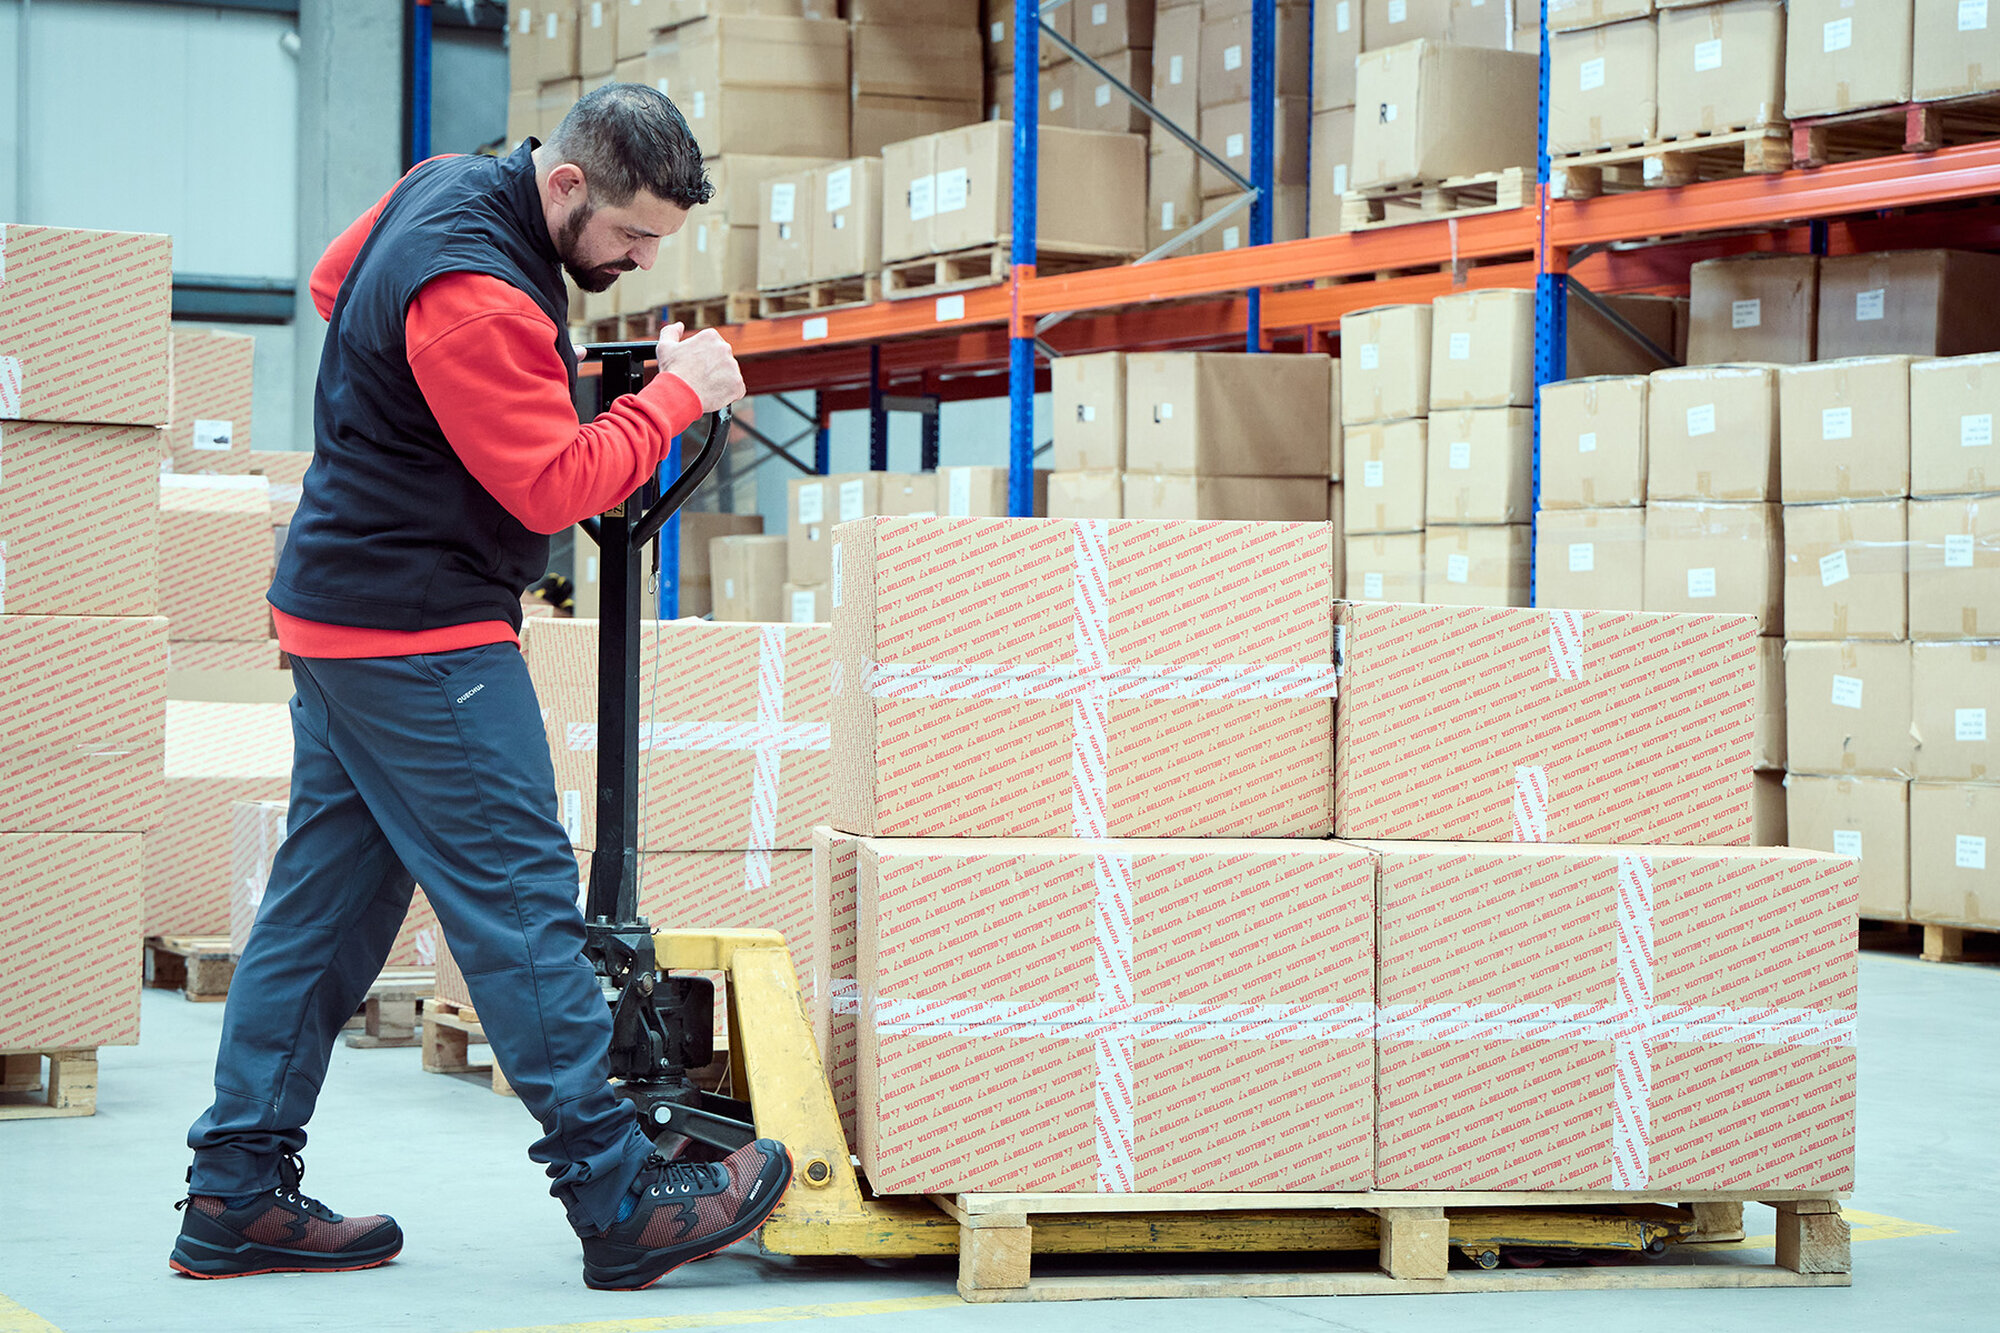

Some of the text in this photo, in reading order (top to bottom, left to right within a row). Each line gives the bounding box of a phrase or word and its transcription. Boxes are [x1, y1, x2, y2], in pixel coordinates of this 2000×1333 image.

[1379, 102, 1388, 124] R
[893, 522, 1004, 572] BELLOTA BELLOTA BELLOTA
[1074, 522, 1089, 552] BELLOTA
[911, 534, 1186, 652] BELLOTA BELLOTA BELLOTA BELLOTA BELLOTA BELLOTA
[1090, 567, 1107, 598] BELLOTA
[1141, 560, 1290, 626] BELLOTA BELLOTA BELLOTA BELLOTA
[1080, 584, 1096, 614] BELLOTA
[1074, 606, 1089, 636] BELLOTA
[1376, 620, 1445, 651] BELLOTA BELLOTA
[1553, 626, 1568, 656] BELLOTA
[1392, 618, 1659, 729] BELLOTA BELLOTA BELLOTA BELLOTA BELLOTA BELLOTA
[893, 710, 1047, 778] BELLOTA BELLOTA BELLOTA BELLOTA
[1351, 672, 1736, 832] BELLOTA BELLOTA BELLOTA BELLOTA BELLOTA BELLOTA BELLOTA BELLOTA BELLOTA
[1111, 726, 1304, 810] BELLOTA BELLOTA BELLOTA BELLOTA BELLOTA
[1567, 750, 1752, 829] BELLOTA BELLOTA BELLOTA BELLOTA BELLOTA
[1630, 870, 1646, 902] BELLOTA
[910, 871, 1075, 945] BELLOTA BELLOTA BELLOTA BELLOTA
[1114, 893, 1131, 926] BELLOTA
[1418, 882, 1578, 953] BELLOTA BELLOTA BELLOTA BELLOTA
[1619, 888, 1636, 920] BELLOTA
[1102, 912, 1119, 944] BELLOTA
[1585, 888, 1830, 994] BELLOTA BELLOTA BELLOTA BELLOTA BELLOTA
[1095, 936, 1112, 969] BELLOTA
[1241, 935, 1361, 990] BELLOTA BELLOTA BELLOTA
[1637, 935, 1653, 967] BELLOTA
[1630, 958, 1646, 990] BELLOTA
[1396, 1004, 1428, 1020] BELLOTA
[1420, 1010, 1452, 1028] BELLOTA
[1484, 1003, 1516, 1020] BELLOTA
[1573, 1004, 1604, 1020] BELLOTA
[1662, 1006, 1692, 1021] BELLOTA
[1748, 1008, 1778, 1023] BELLOTA
[1788, 1027, 1819, 1043] BELLOTA
[891, 1043, 967, 1079] BELLOTA BELLOTA
[1628, 1050, 1644, 1082] BELLOTA
[1114, 1072, 1132, 1105] BELLOTA
[1401, 1050, 1606, 1140] BELLOTA BELLOTA BELLOTA BELLOTA BELLOTA
[1616, 1068, 1632, 1100] BELLOTA
[988, 1058, 1286, 1188] BELLOTA BELLOTA BELLOTA BELLOTA BELLOTA
[1102, 1092, 1120, 1124] BELLOTA
[1532, 1051, 1821, 1176] BELLOTA BELLOTA BELLOTA BELLOTA BELLOTA BELLOTA
[1096, 1116, 1113, 1149] BELLOTA
[1634, 1115, 1650, 1146] BELLOTA
[1626, 1138, 1642, 1170] BELLOTA
[1285, 1155, 1361, 1190] BELLOTA BELLOTA
[1614, 1156, 1630, 1188] BELLOTA
